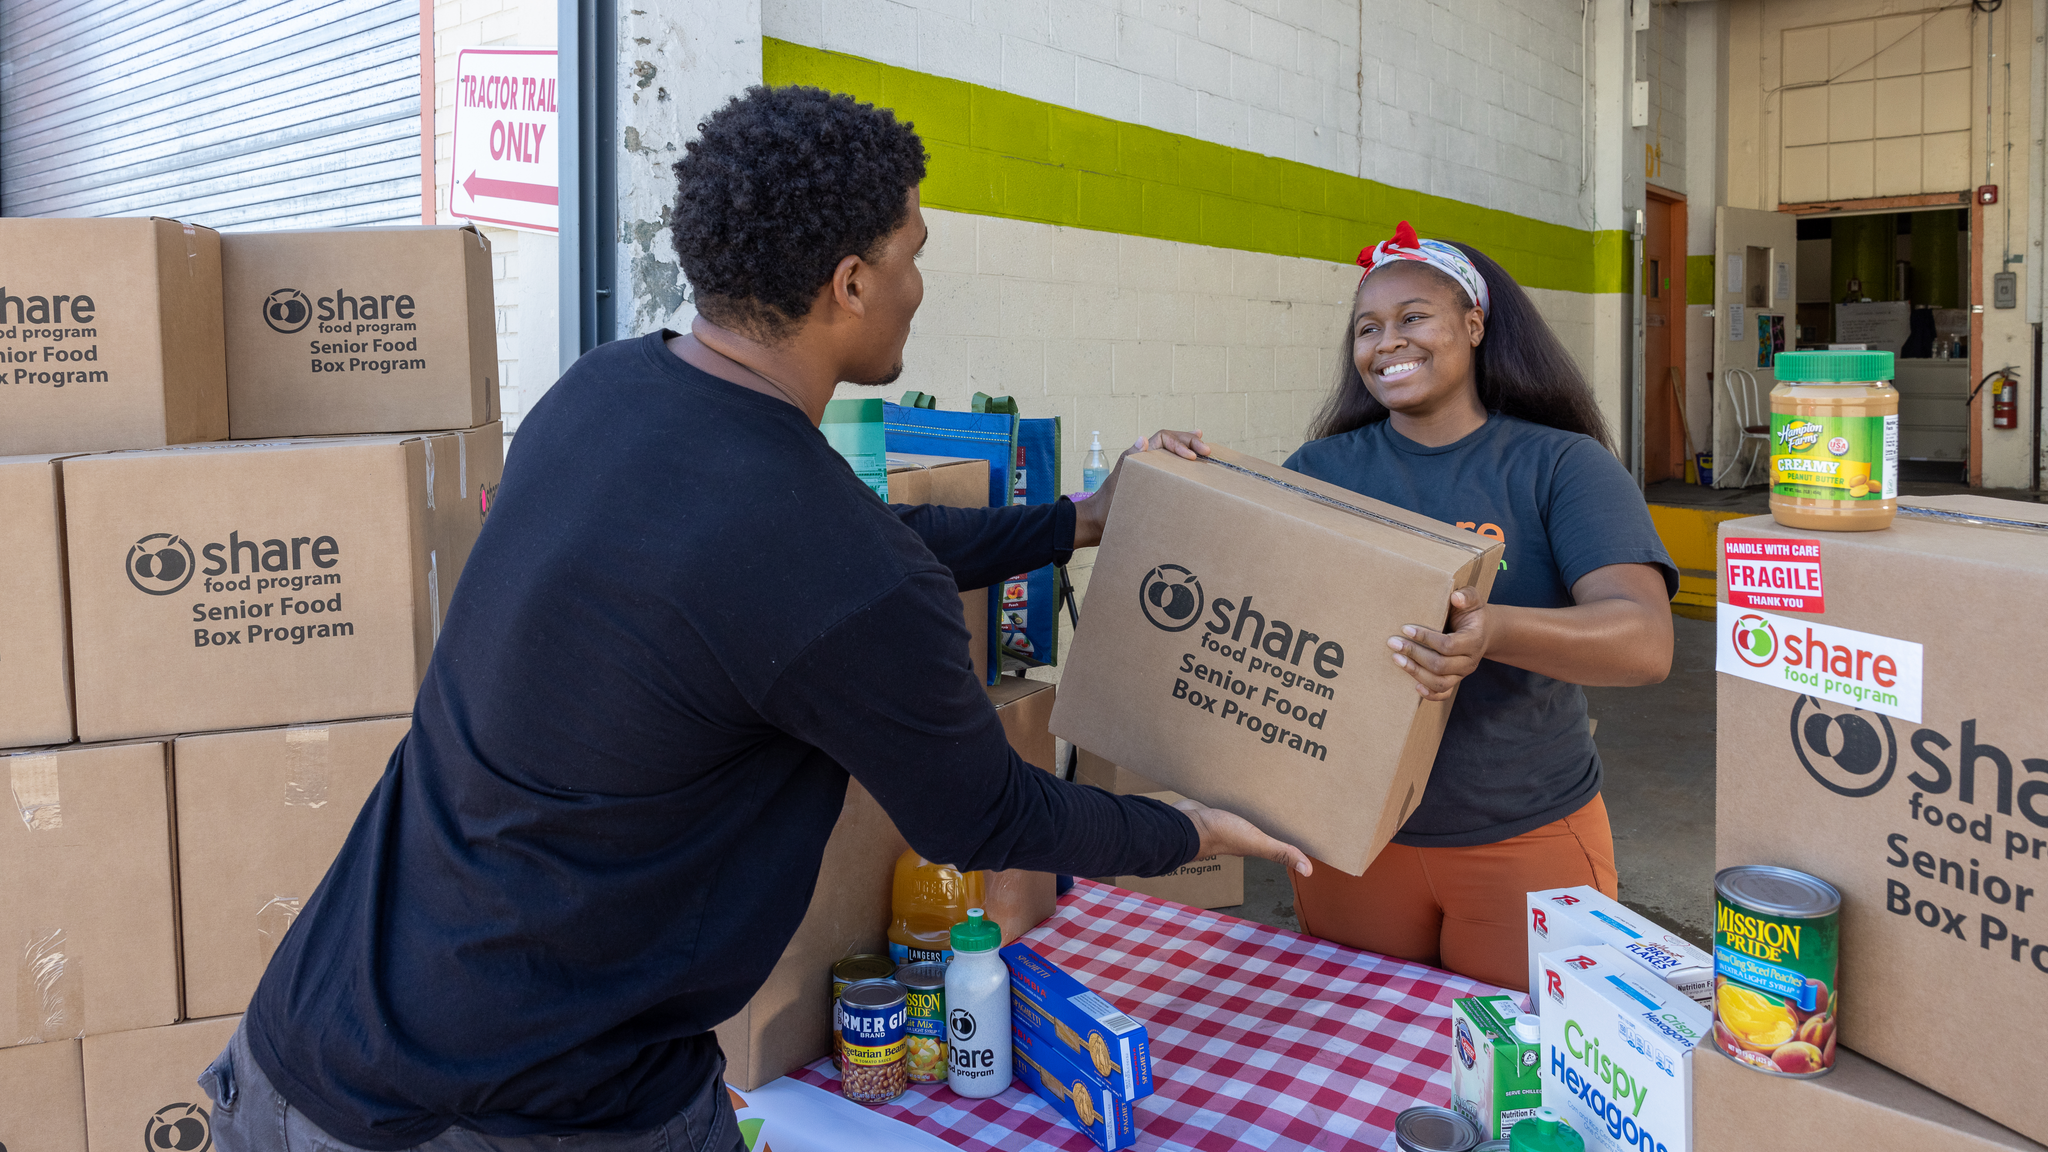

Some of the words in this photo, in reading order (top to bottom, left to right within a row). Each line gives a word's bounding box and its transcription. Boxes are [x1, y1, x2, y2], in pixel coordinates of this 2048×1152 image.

[464, 75, 518, 110] TRACTOR
[522, 77, 558, 113] TRAIL
[490, 119, 546, 164] ONLY
[0, 286, 95, 324] hare
[317, 288, 416, 322] share
[22, 326, 97, 342] program
[318, 321, 352, 334] food
[356, 321, 417, 336] program
[43, 345, 98, 362] Food
[310, 339, 368, 355] Senior
[373, 337, 417, 353] Food
[14, 368, 109, 388] Program
[311, 359, 345, 373] Box
[350, 358, 426, 374] Program
[1777, 421, 1823, 446] Hampton
[1787, 432, 1819, 454] Farms
[1830, 441, 1846, 450] USA
[1777, 458, 1841, 474] CREAMY
[1787, 472, 1813, 482] PEANUT
[1815, 475, 1845, 485] BUTTER
[202, 530, 340, 577] share
[1726, 543, 1763, 555] HANDLE
[1764, 543, 1790, 556] WITH
[1792, 545, 1819, 557] CARE
[204, 575, 251, 593] food
[257, 573, 342, 594] program
[1730, 564, 1820, 591] FRAGILE
[192, 600, 274, 622] Senior
[280, 592, 342, 616] Food
[1748, 595, 1781, 607] THANK
[1782, 598, 1804, 608] YOU
[193, 628, 241, 647] Box
[247, 621, 355, 645] Program
[1205, 596, 1345, 679] share
[1200, 631, 1247, 663] food
[1248, 655, 1335, 701] program
[1783, 627, 1897, 688] share
[1179, 653, 1258, 700] Senior
[1261, 686, 1328, 730] Food
[1785, 665, 1819, 687] food
[1824, 678, 1898, 707] program
[1171, 677, 1218, 714] Box
[1220, 698, 1328, 762] Program
[1907, 718, 2048, 830] sha
[1908, 791, 1993, 845] food
[1180, 863, 1221, 876] Program
[1886, 833, 2035, 913] Senior
[1886, 878, 1968, 941] Box
[1717, 900, 1801, 960] MISSION
[909, 948, 941, 962] LANGERS
[1626, 943, 1671, 970] FLAKES
[1645, 946, 1682, 966] BRAN
[1726, 931, 1782, 962] PRIDE
[1015, 954, 1051, 979] SPAGHETTI
[1725, 964, 1743, 978] EXTRA
[1744, 973, 1767, 985] LIGHT
[1769, 981, 1795, 993] SYRUP
[1730, 955, 1746, 972] Cling
[1747, 961, 1769, 977] Sliced
[1771, 968, 1803, 987] Peaches
[1006, 963, 1047, 998] OLUMBIA
[1677, 982, 1706, 991] Nutrition
[907, 992, 940, 1013] SSION
[907, 1007, 931, 1017] RIDE
[843, 1011, 886, 1033] RMER
[860, 1031, 886, 1039] BRAND
[917, 1020, 933, 1029] Mix
[1011, 1023, 1033, 1047] MBIA
[1642, 1012, 1694, 1048] Hexagons
[1661, 1013, 1702, 1039] Crispy
[885, 1041, 906, 1057] Beans
[948, 1038, 994, 1068] hare
[957, 1068, 994, 1080] program
[1139, 1043, 1148, 1085] SPAGHETTI
[1564, 1019, 1648, 1117] Crispy
[1501, 1110, 1528, 1119] Nutrition
